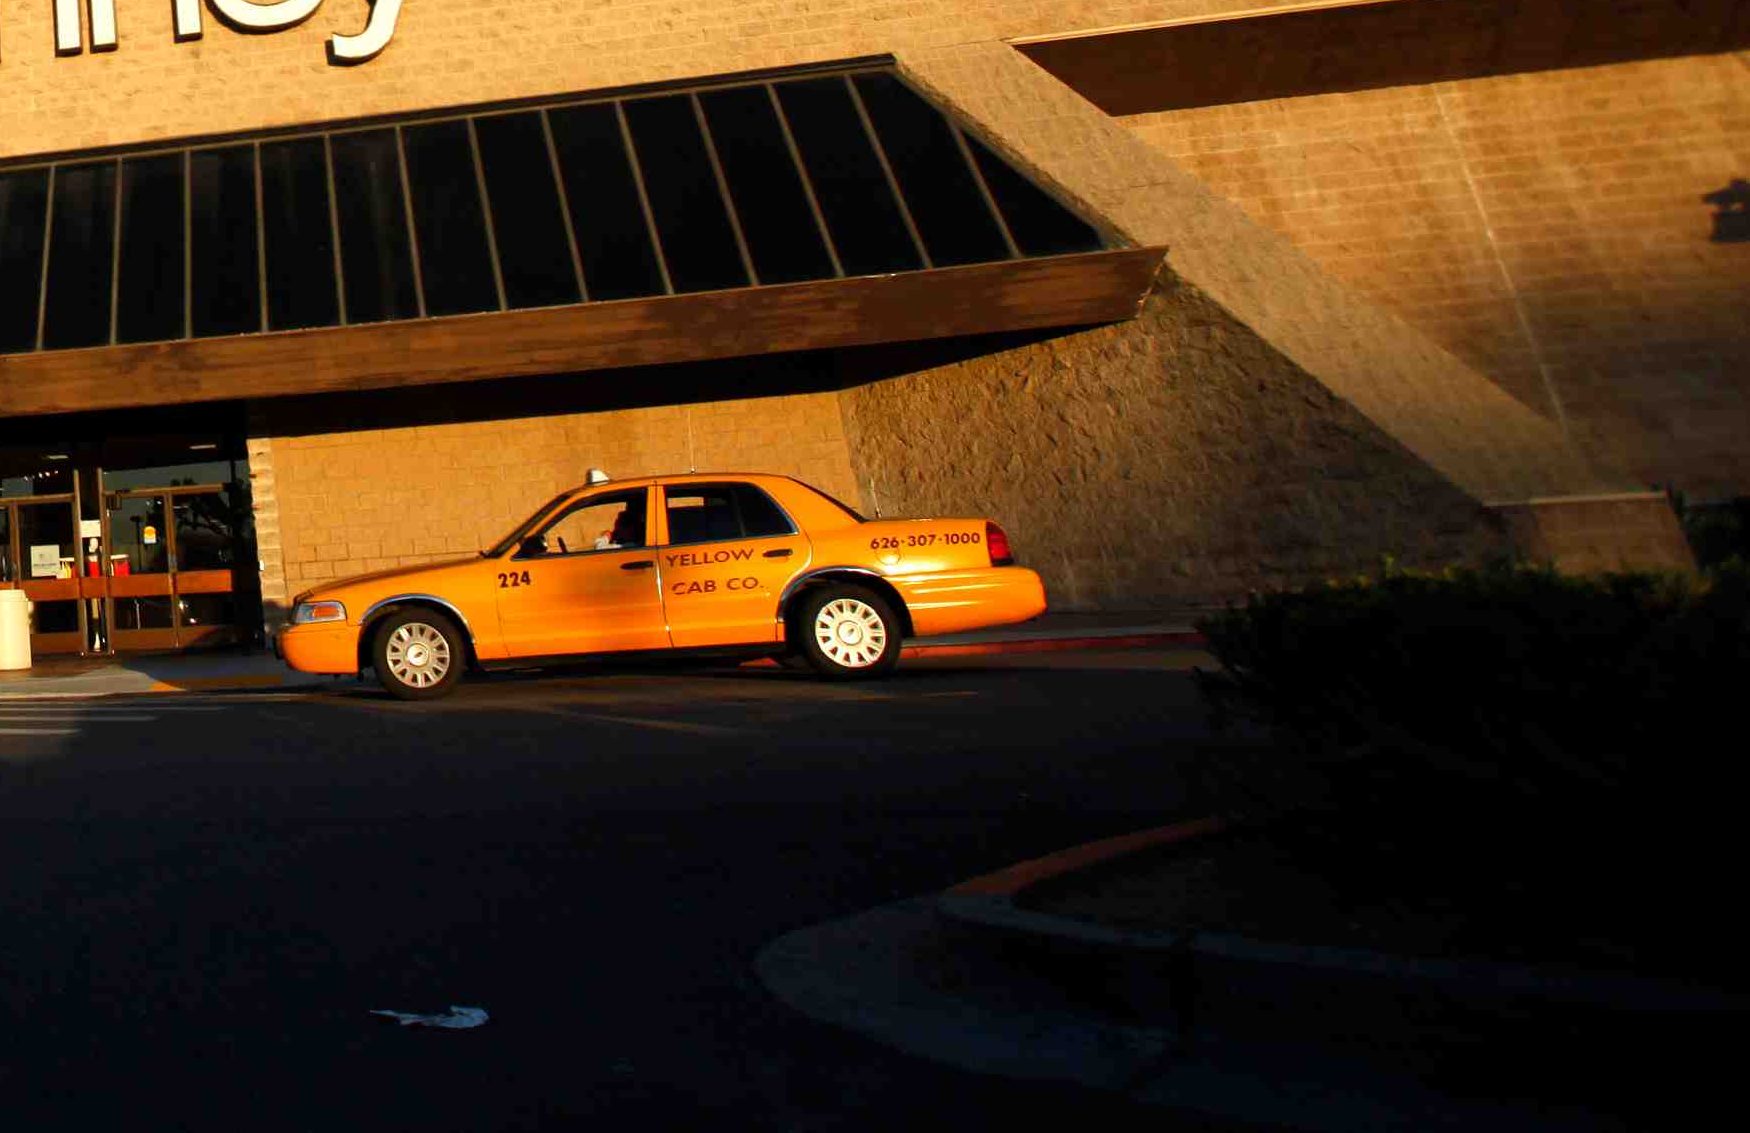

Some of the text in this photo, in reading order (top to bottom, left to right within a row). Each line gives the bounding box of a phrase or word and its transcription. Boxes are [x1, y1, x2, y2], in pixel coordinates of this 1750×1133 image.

[666, 549, 754, 567] YELLOW
[498, 571, 531, 588] 224
[672, 577, 765, 595] CAB CO.
